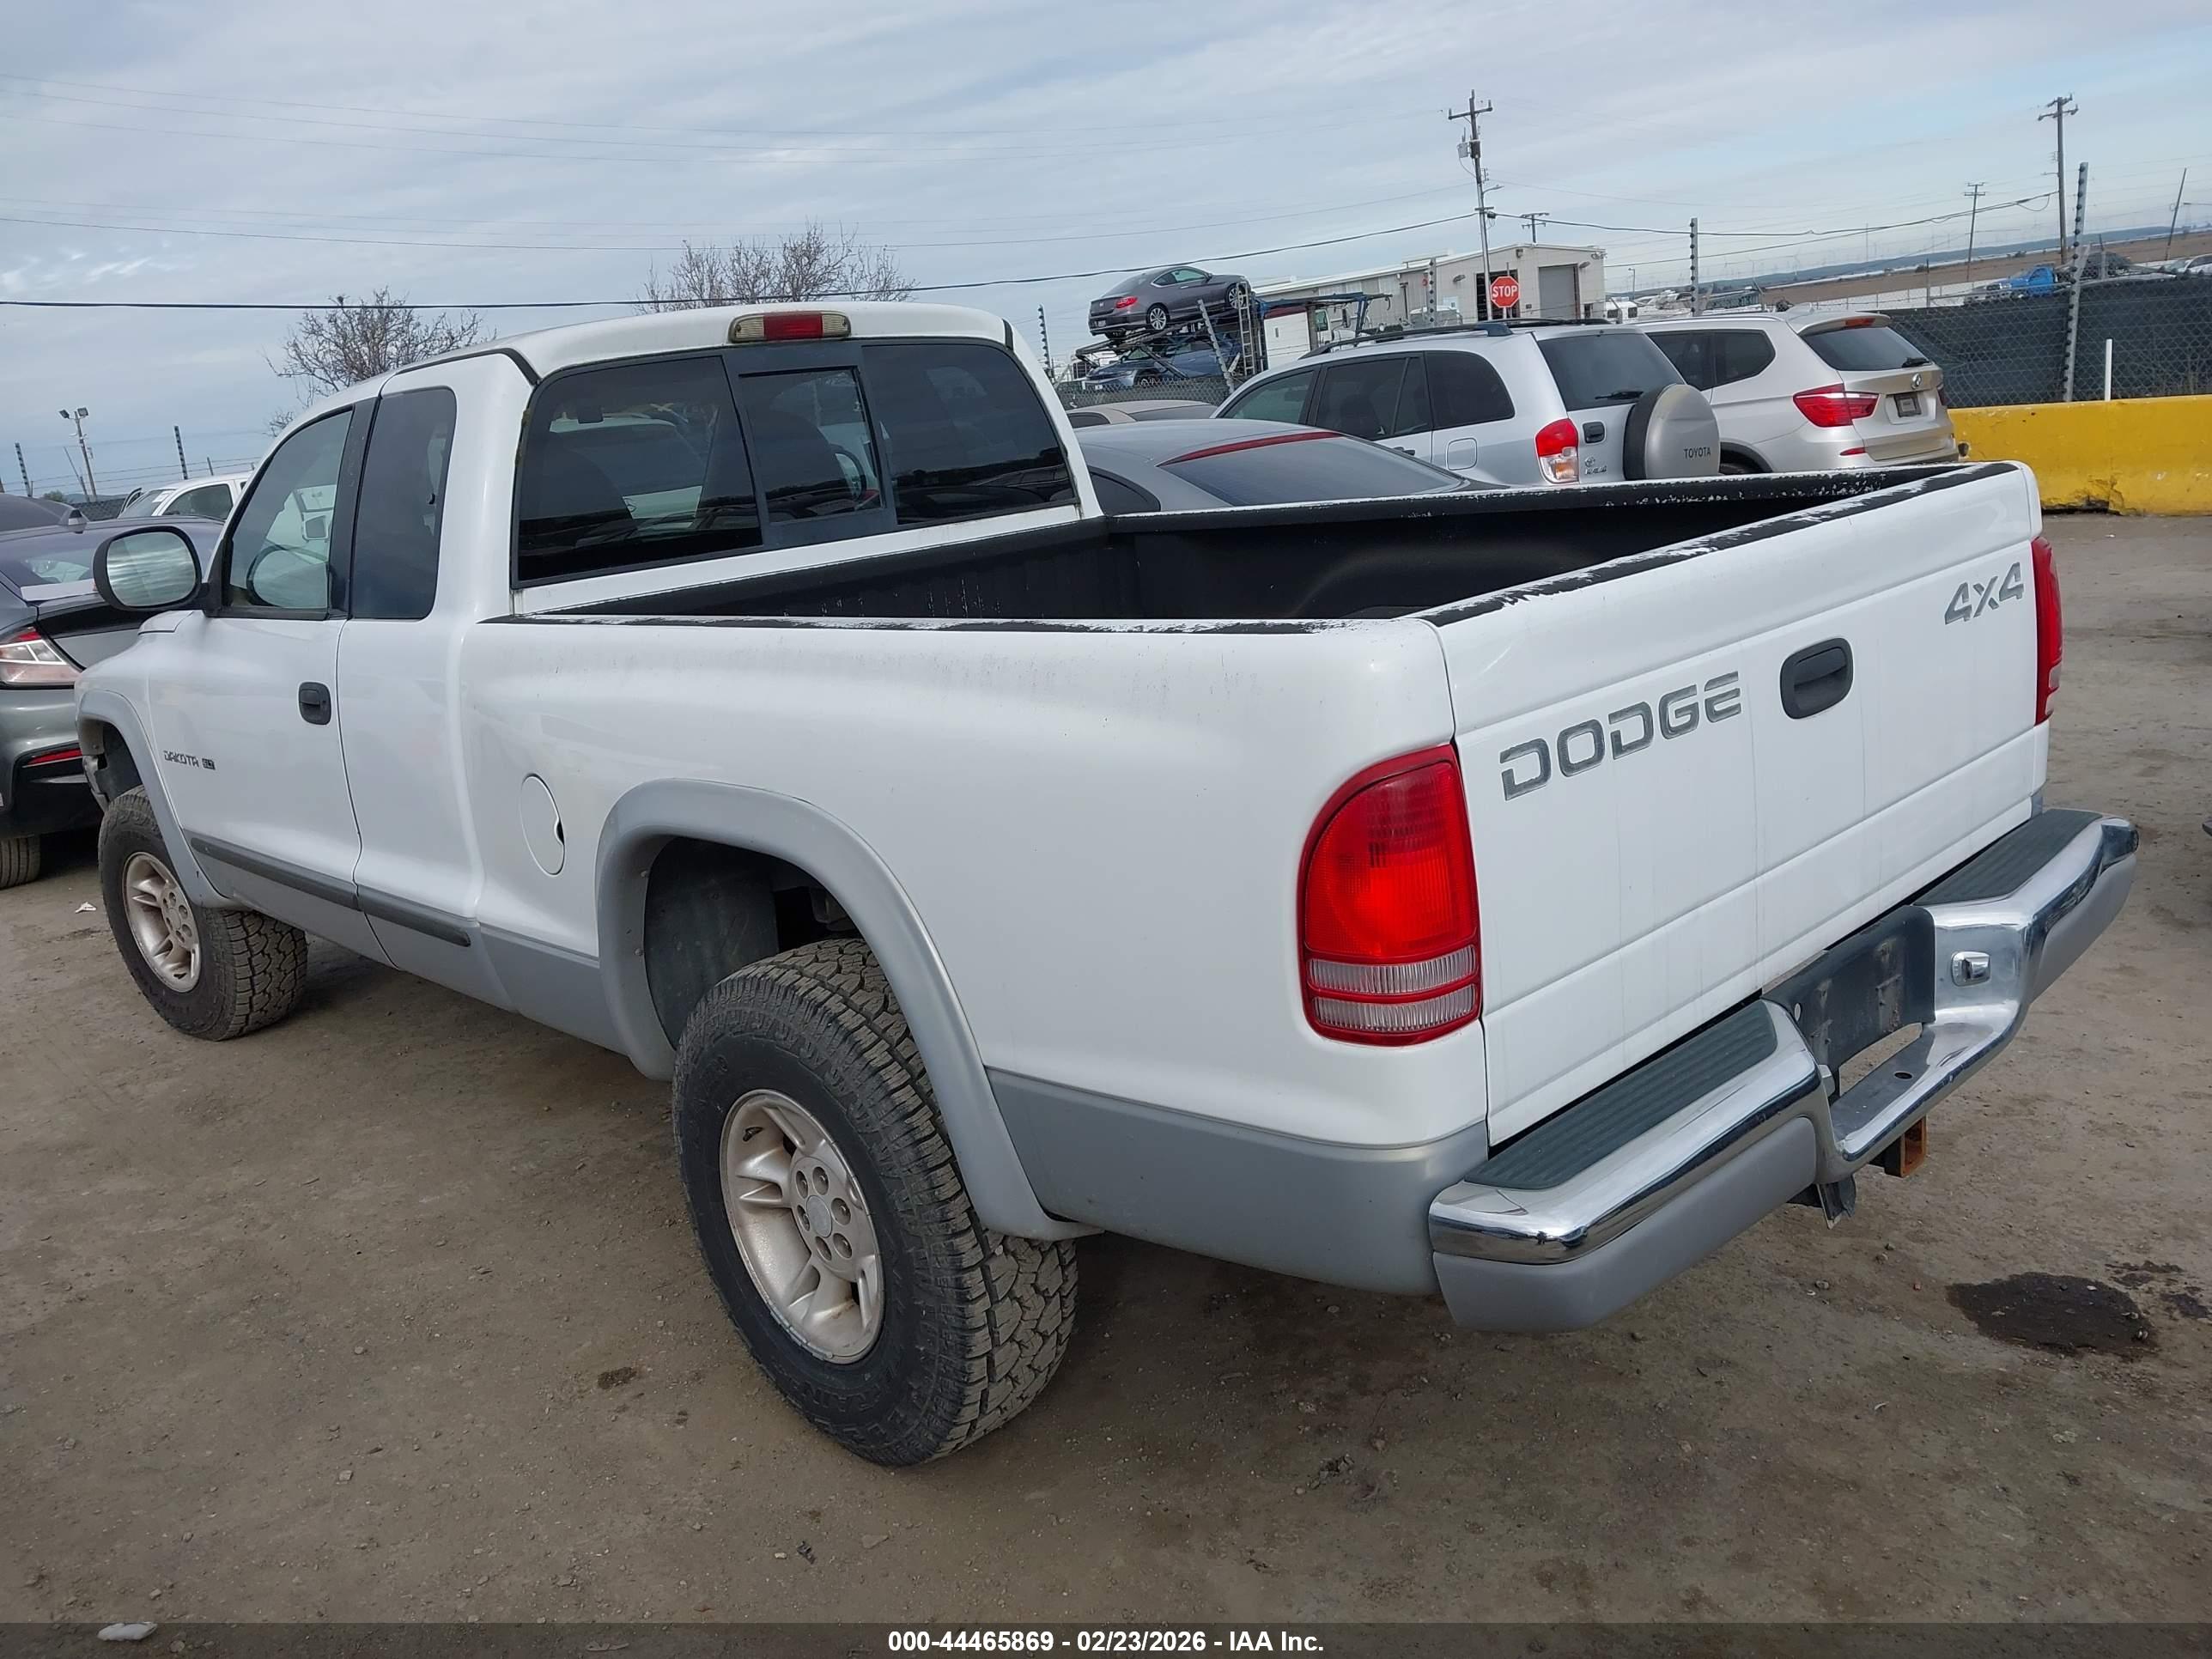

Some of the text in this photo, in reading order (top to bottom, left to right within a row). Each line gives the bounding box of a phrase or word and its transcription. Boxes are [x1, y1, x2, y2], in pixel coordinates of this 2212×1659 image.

[1492, 285, 1517, 298] STOP
[1684, 447, 1711, 459] TOYOTA
[1499, 671, 1741, 801] DODGE
[163, 750, 200, 769] DAKOTA
